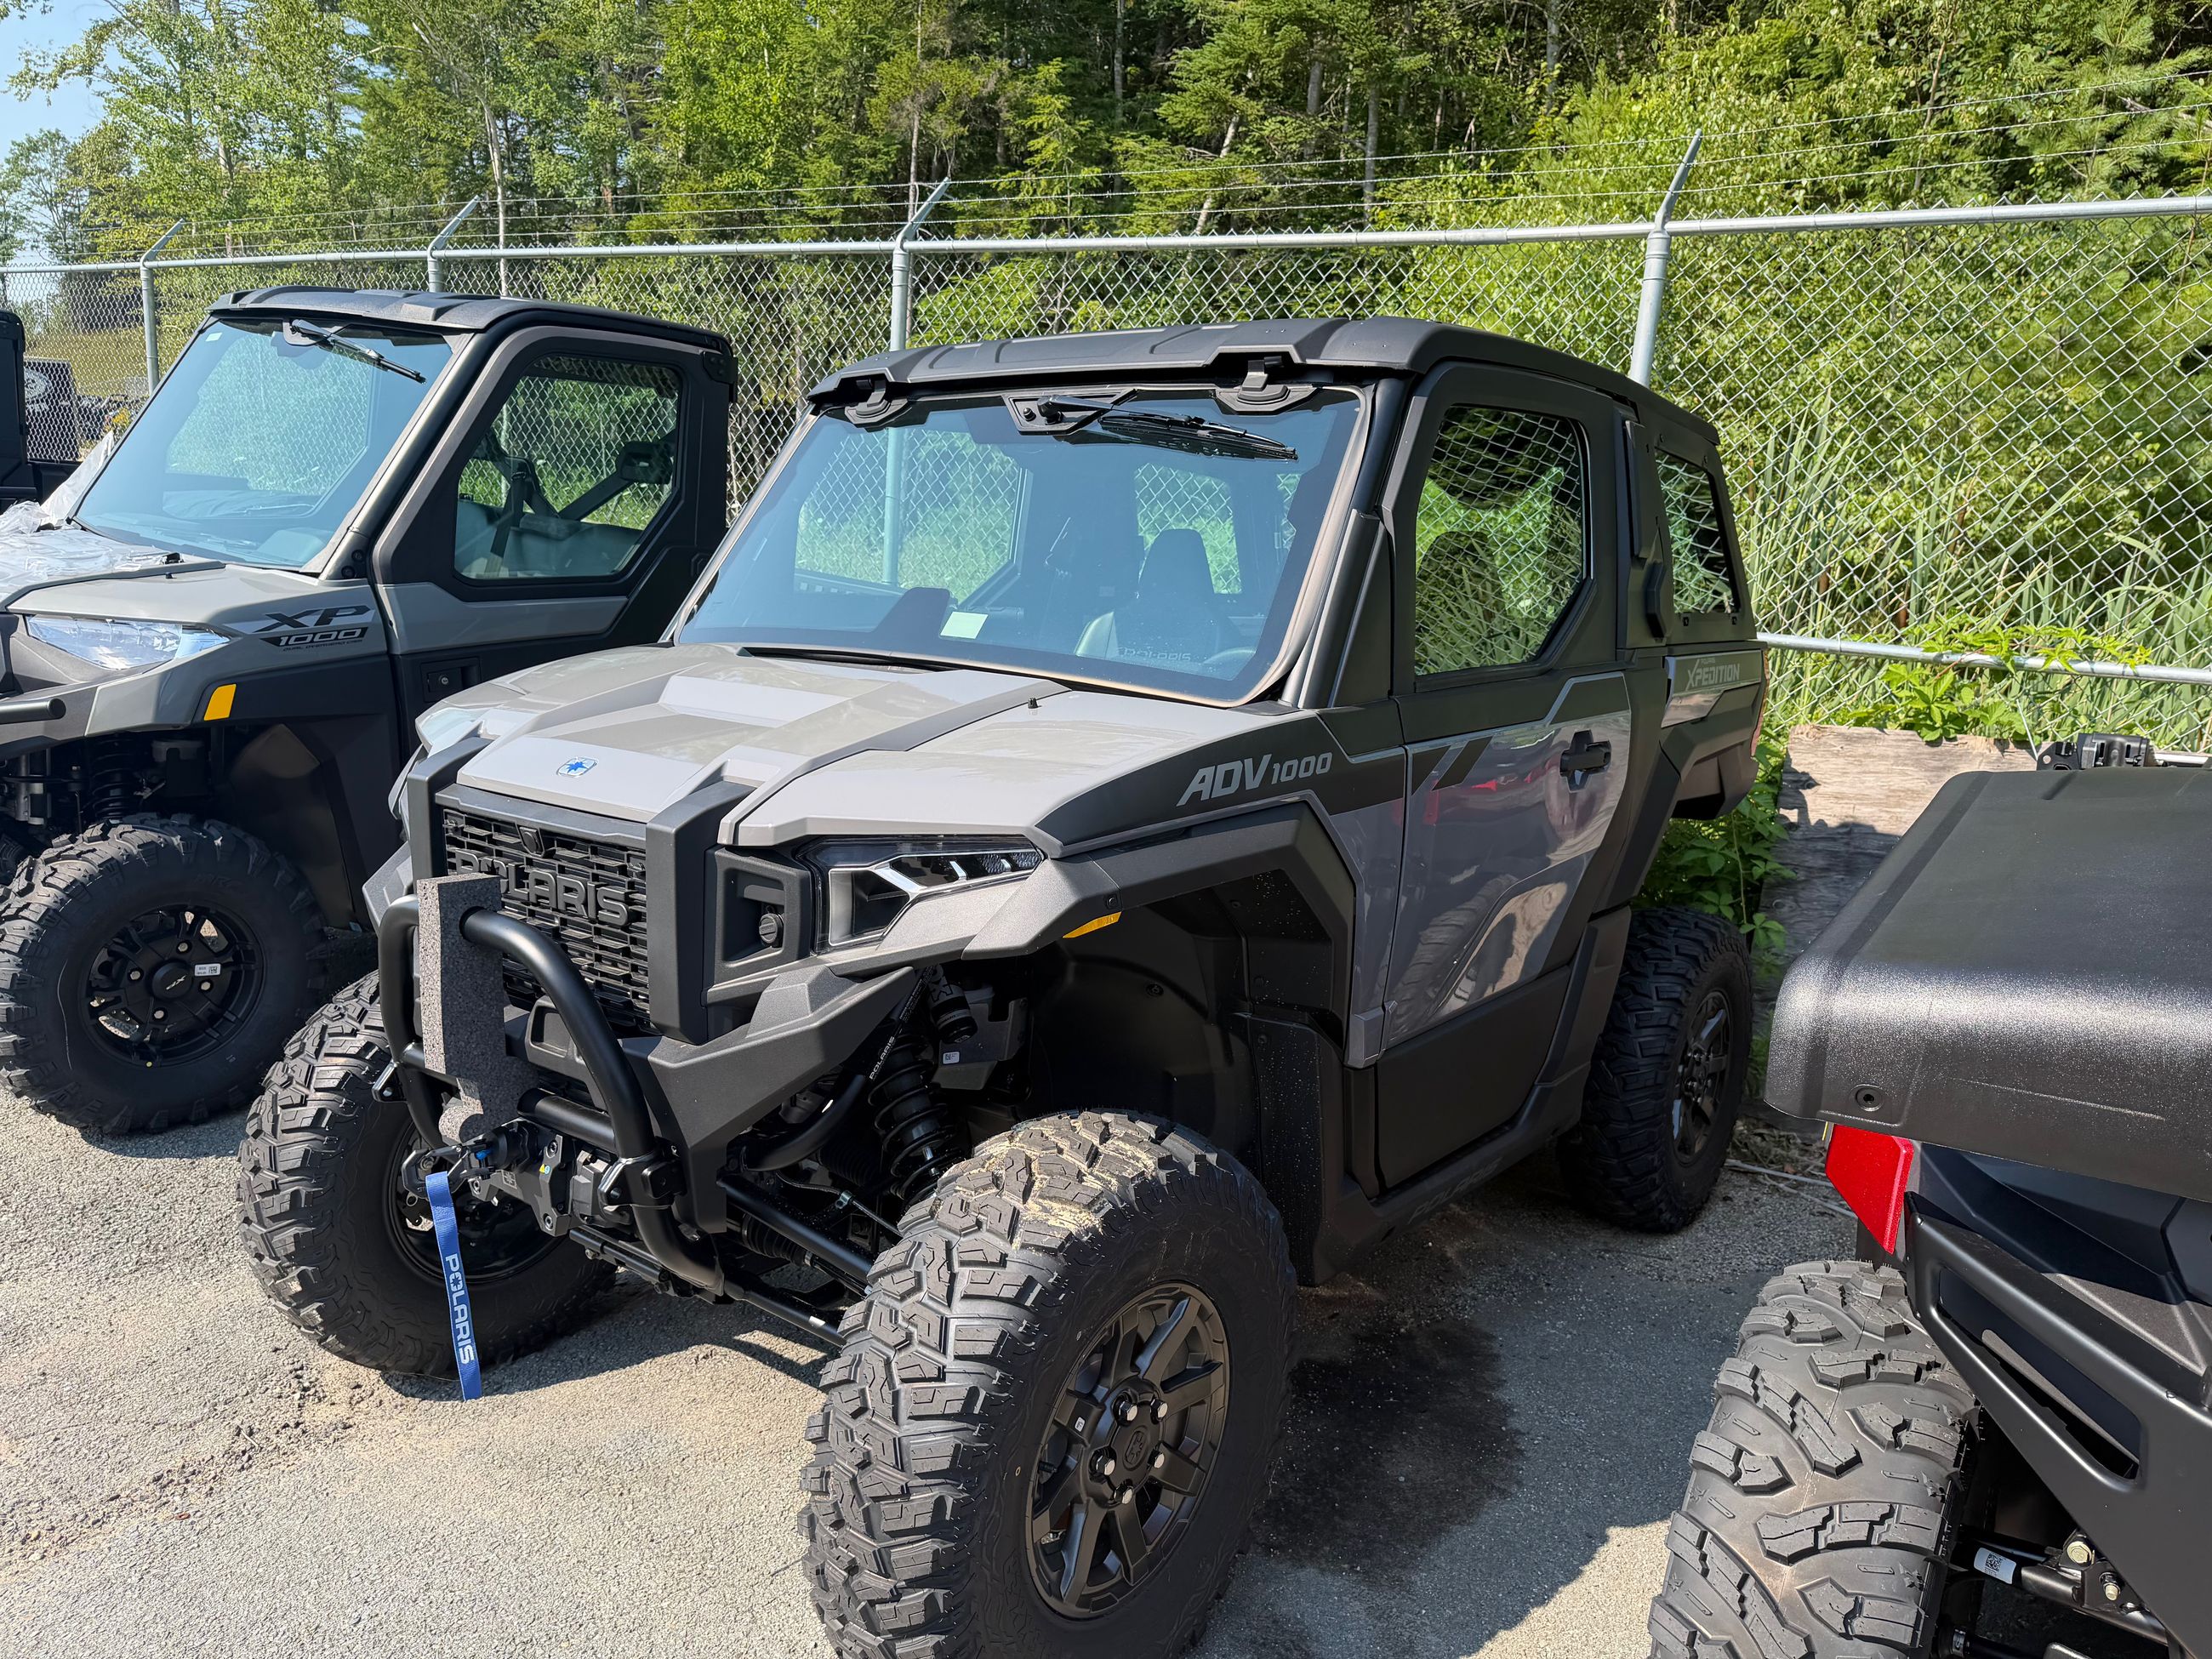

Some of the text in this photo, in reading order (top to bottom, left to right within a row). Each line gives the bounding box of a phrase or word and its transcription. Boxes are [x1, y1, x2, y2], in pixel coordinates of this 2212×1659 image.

[253, 605, 371, 633] XP
[279, 629, 362, 646] 1000
[1685, 658, 1741, 692] XPEDITION
[1176, 752, 1333, 807] ADV 1000
[869, 1035, 896, 1080] POLARIS
[445, 1253, 475, 1365] POLARIS
